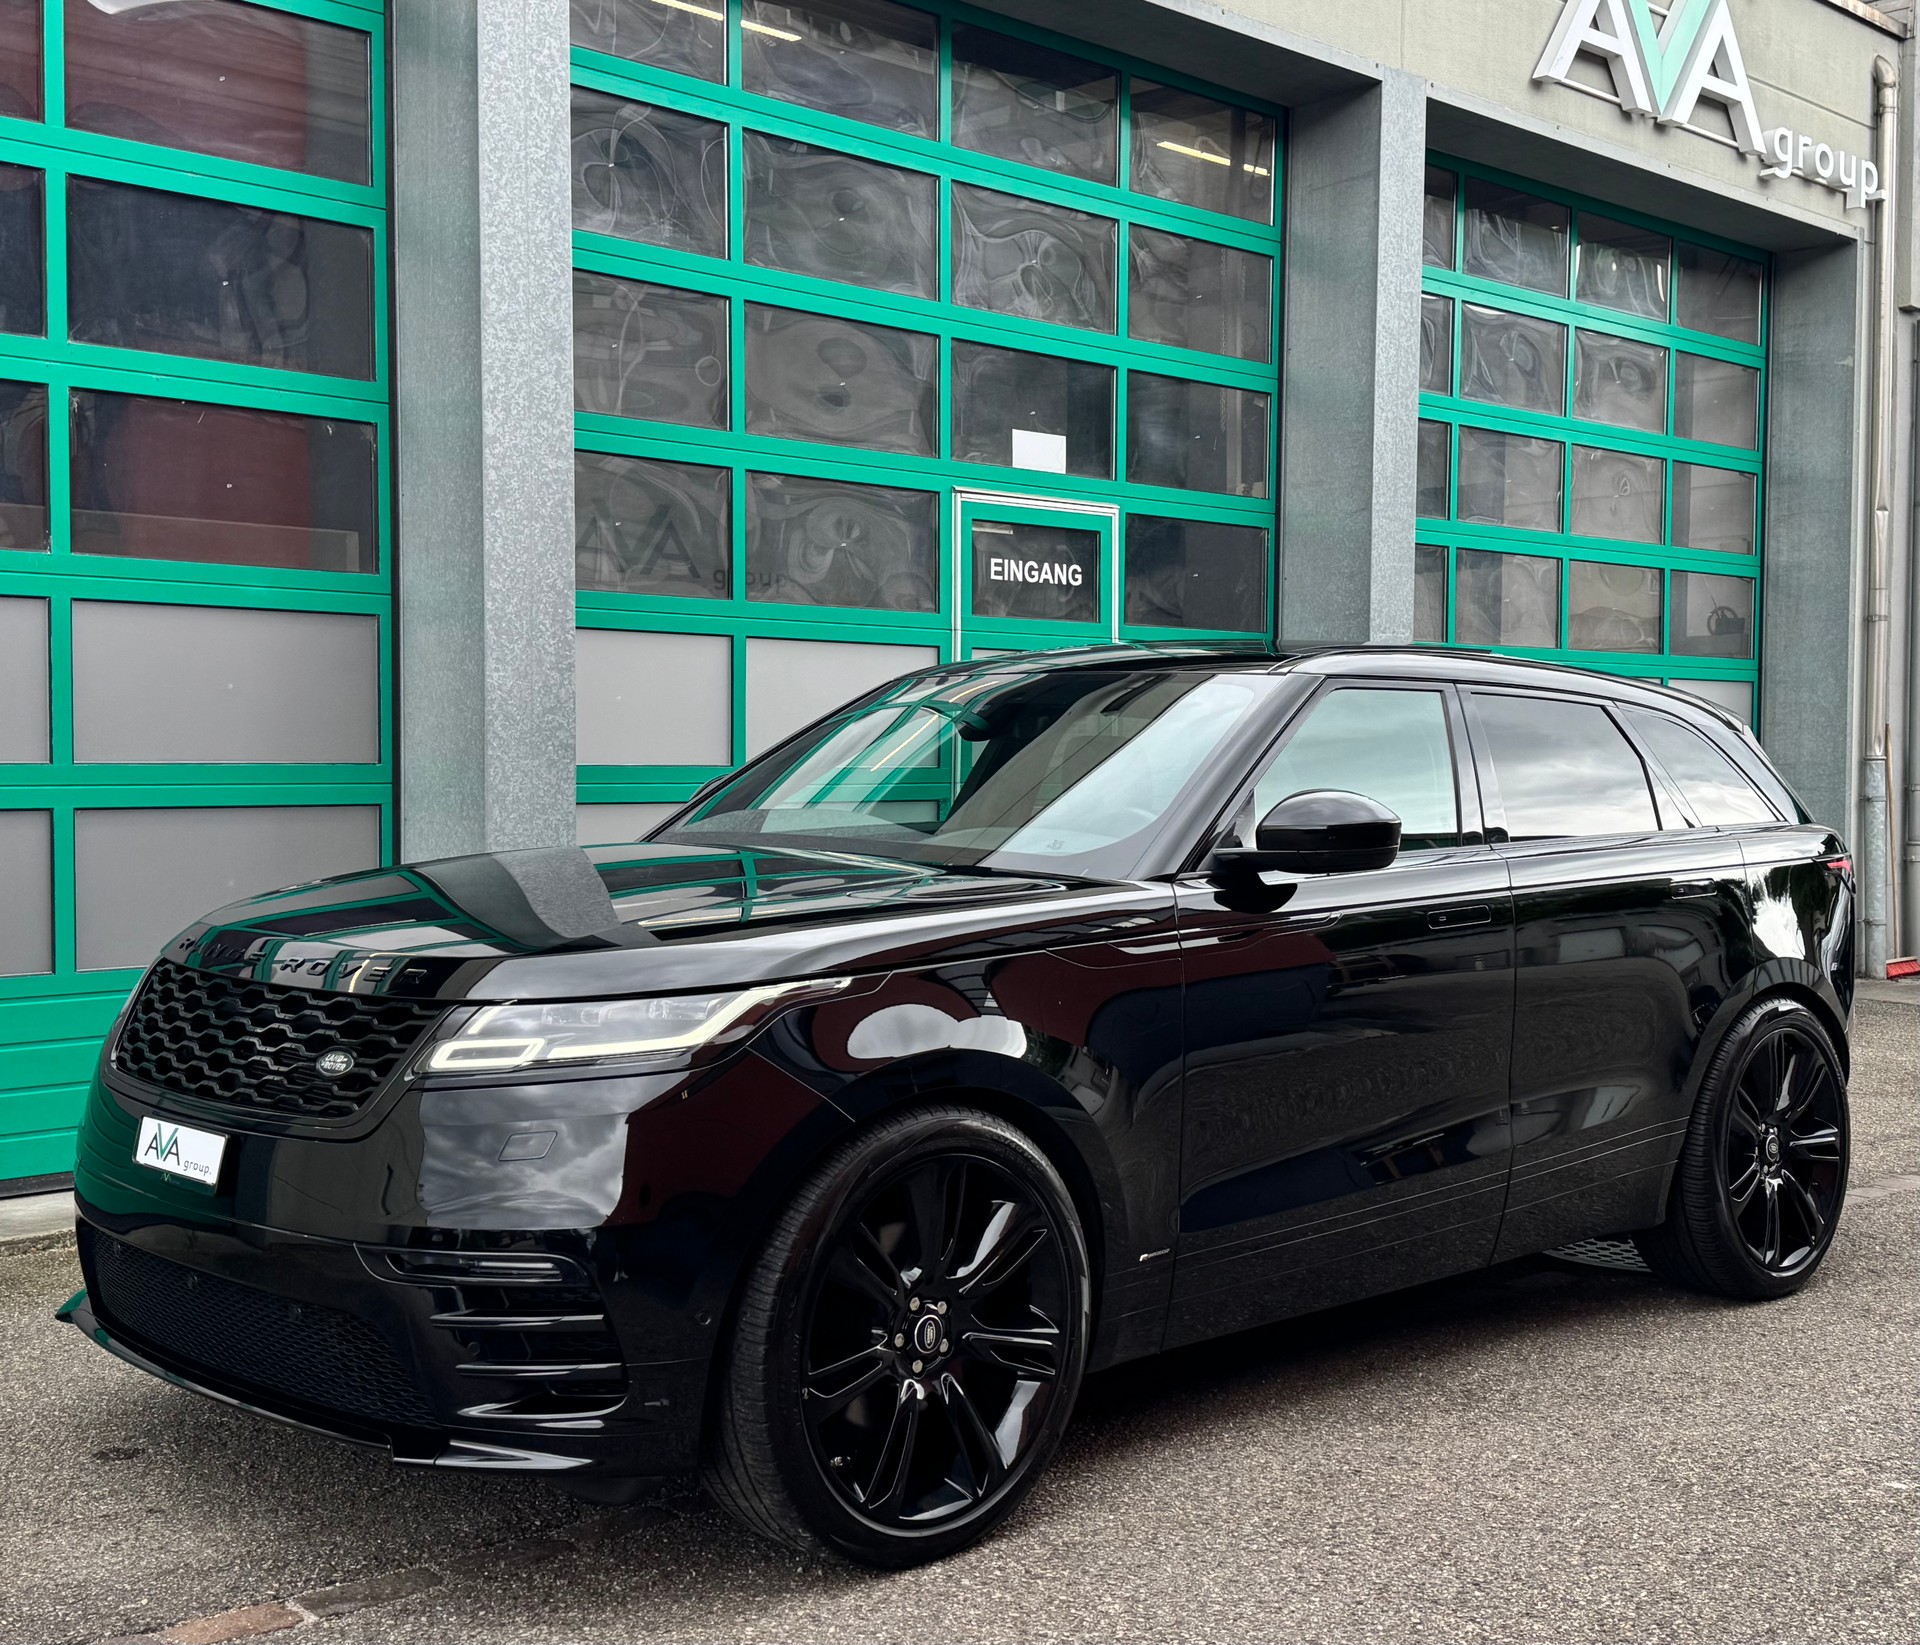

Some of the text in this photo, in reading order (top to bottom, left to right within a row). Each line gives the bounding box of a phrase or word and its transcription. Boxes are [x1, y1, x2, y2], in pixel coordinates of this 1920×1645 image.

[1532, 0, 1880, 208] AVA group
[990, 557, 1083, 586] EINGANG
[279, 957, 428, 985] ROVER
[322, 1061, 347, 1072] ROVER
[144, 1122, 212, 1177] AVA group.
